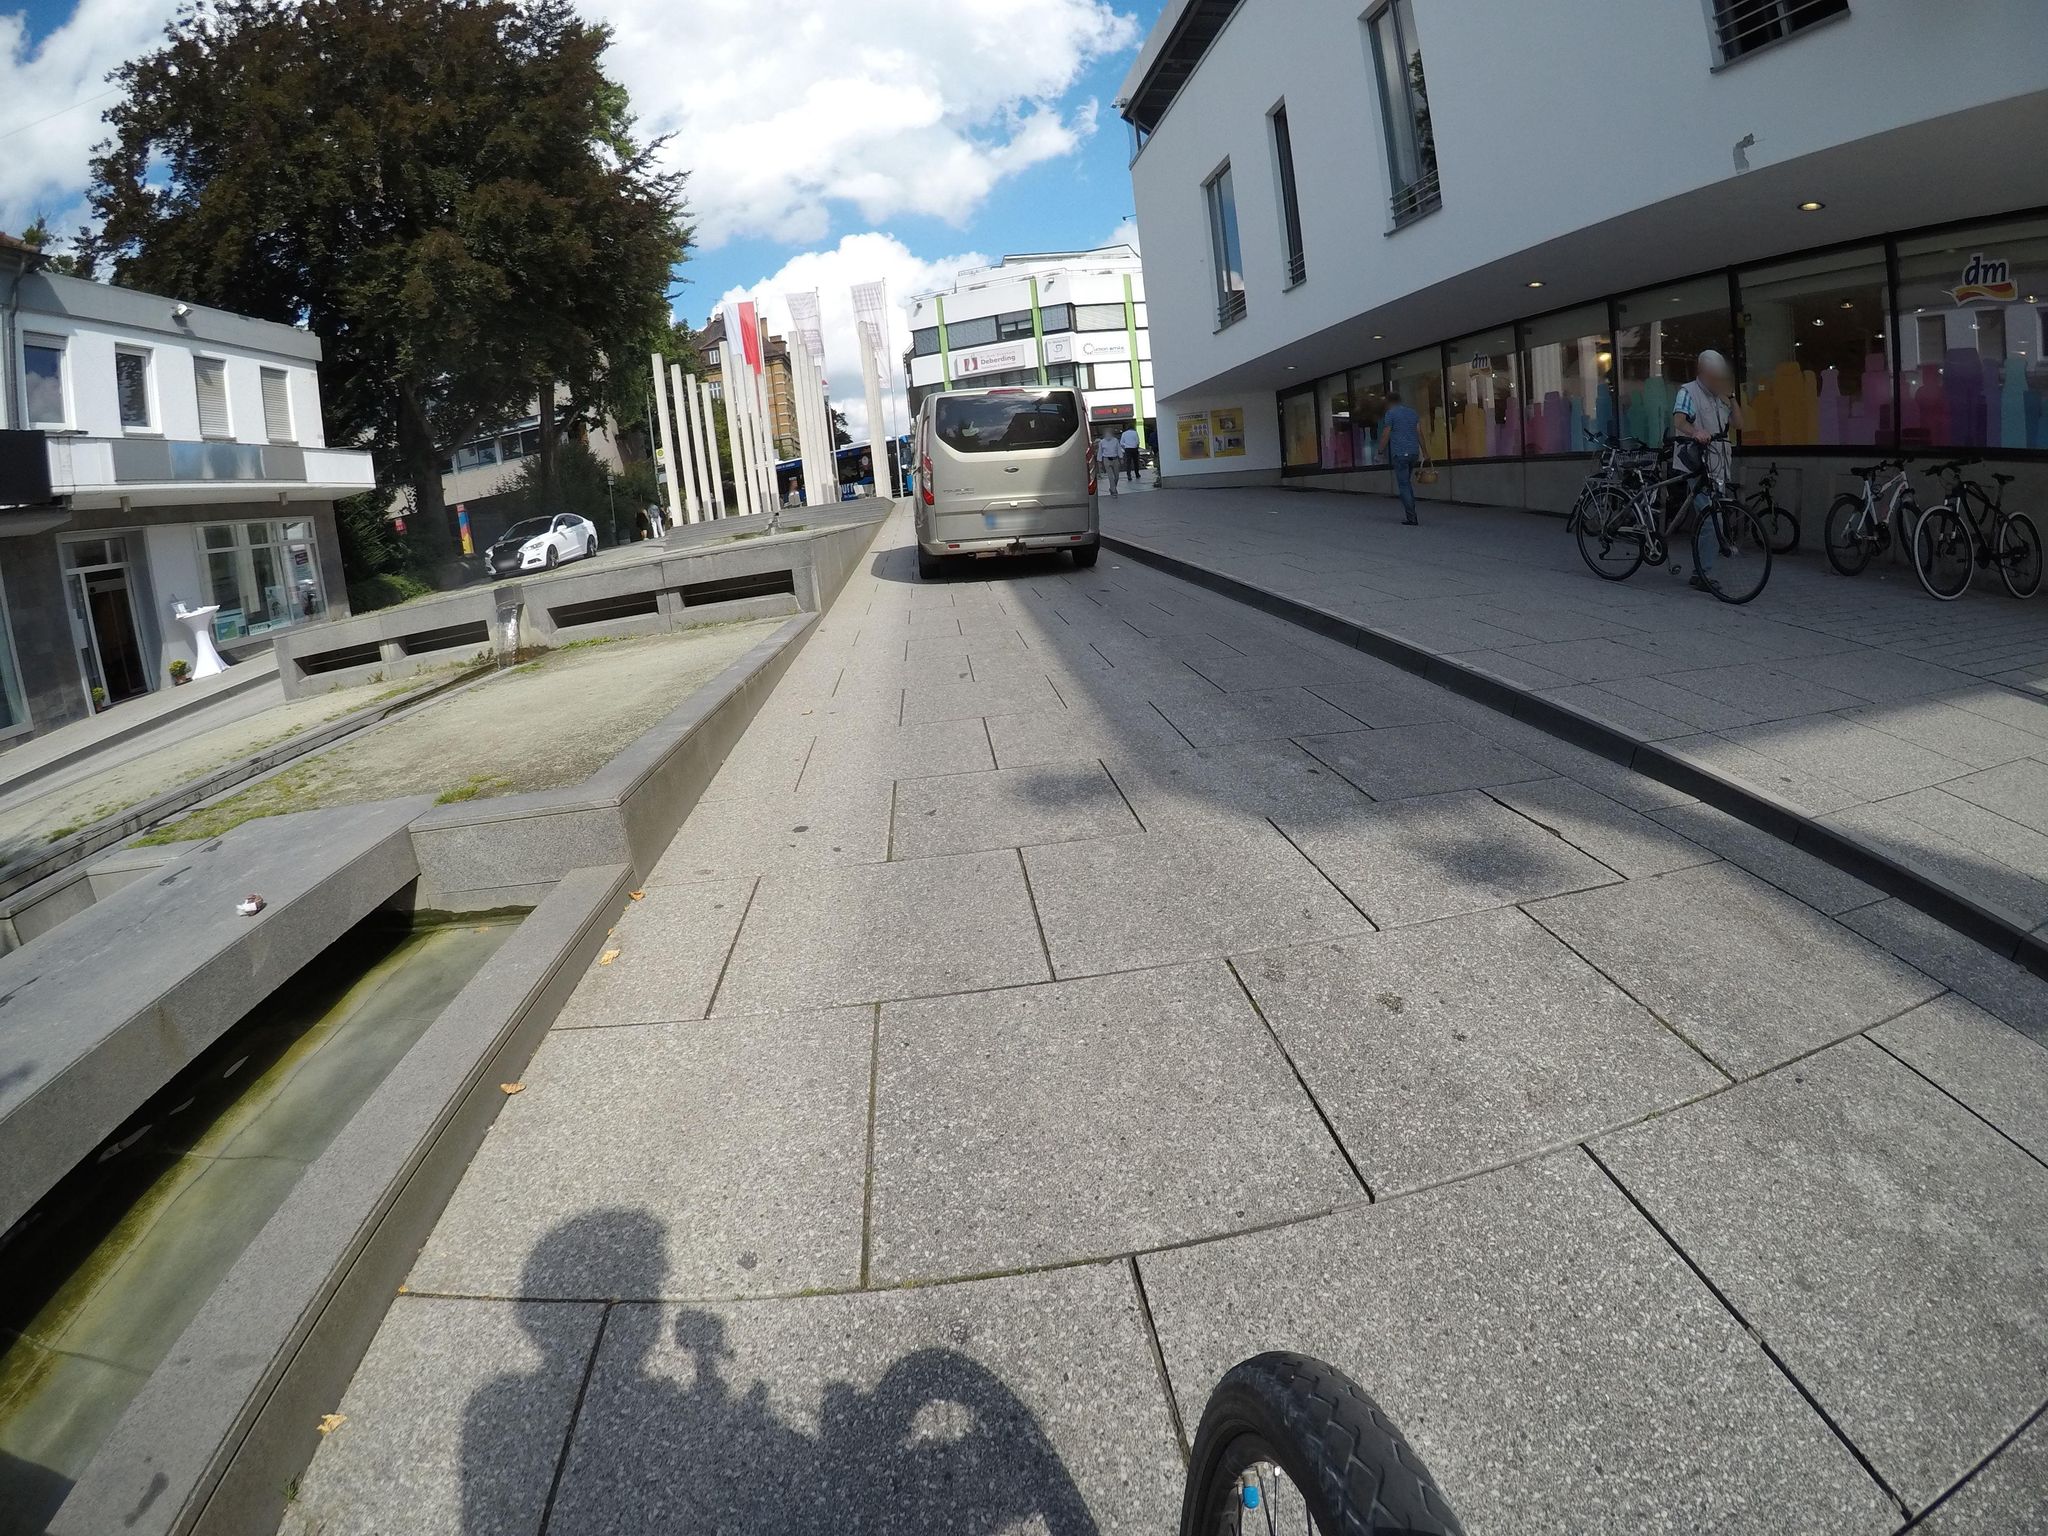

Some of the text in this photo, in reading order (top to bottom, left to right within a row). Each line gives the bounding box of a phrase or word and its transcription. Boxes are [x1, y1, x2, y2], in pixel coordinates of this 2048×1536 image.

[1964, 255, 2007, 285] dm
[980, 354, 1016, 365] Deberding
[1472, 353, 1488, 369] dm
